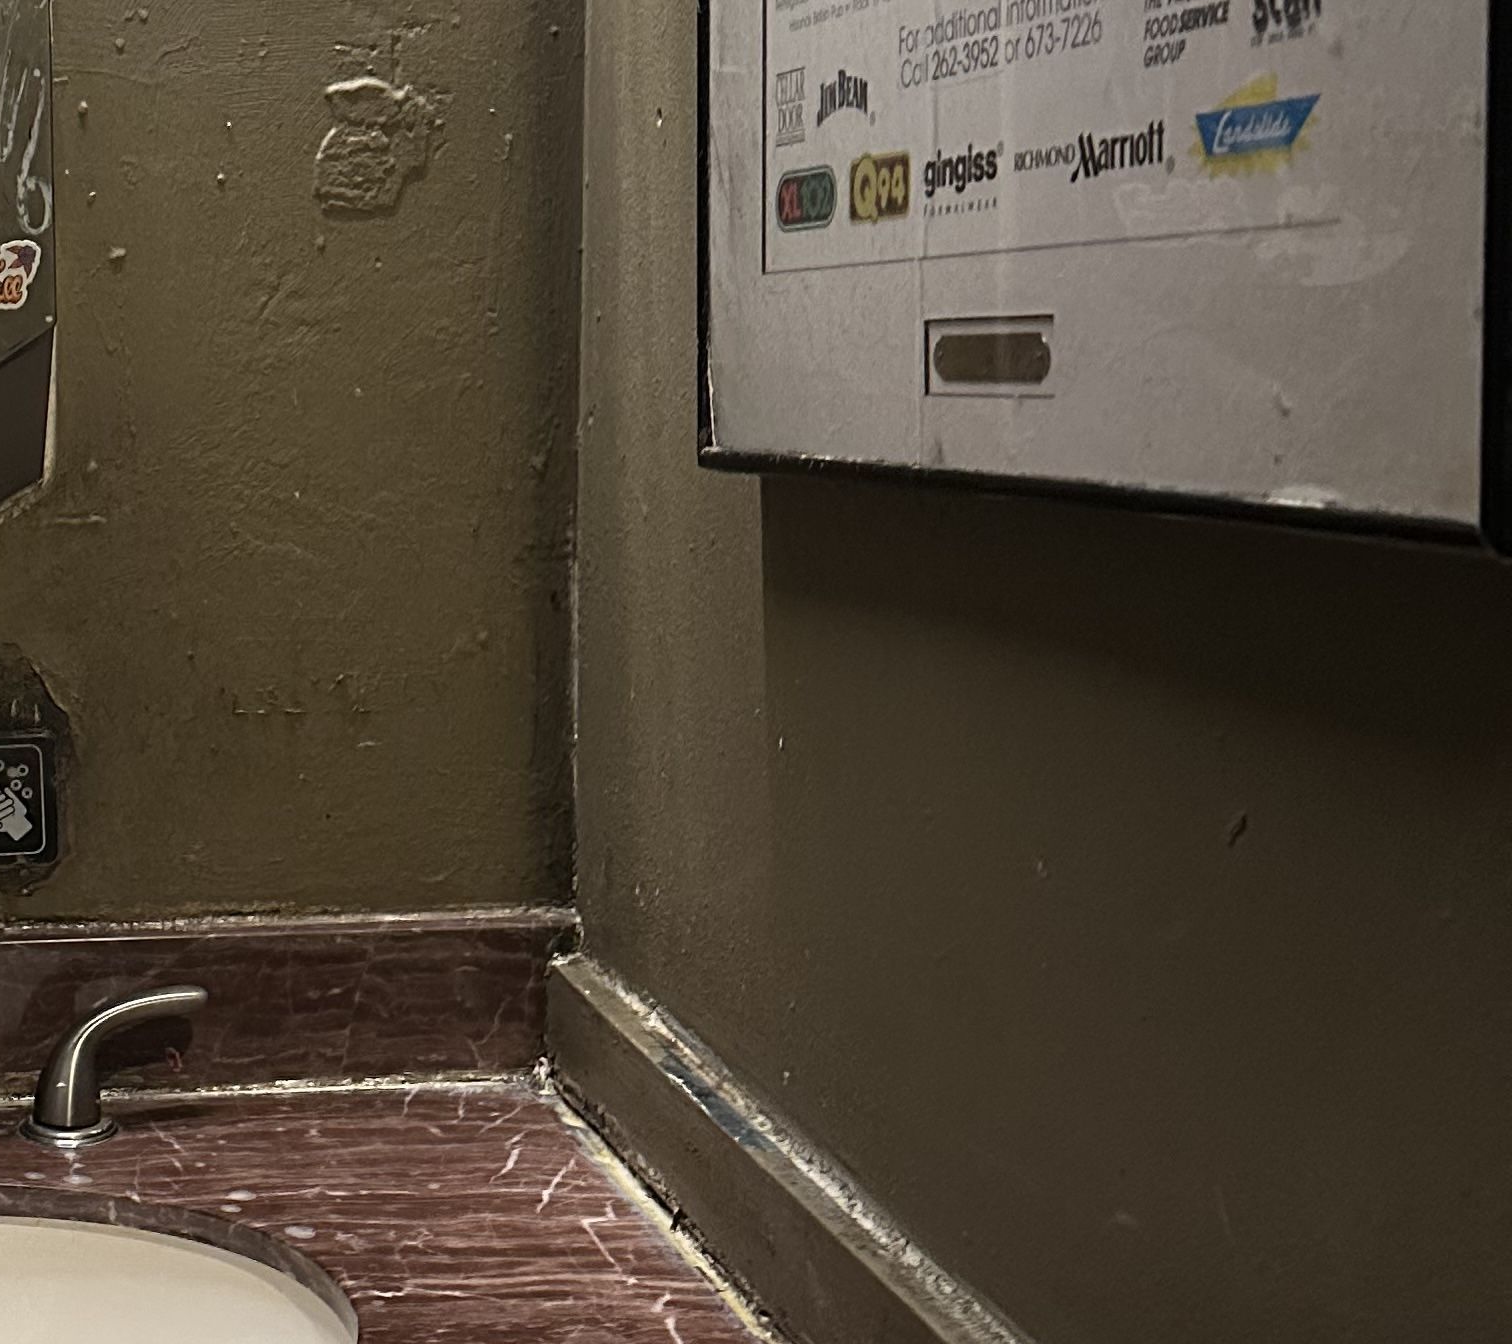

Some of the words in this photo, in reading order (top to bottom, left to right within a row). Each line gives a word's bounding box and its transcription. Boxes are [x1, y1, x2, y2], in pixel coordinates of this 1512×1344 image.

[898, 24, 920, 57] For
[925, 0, 1002, 50] additional
[900, 53, 930, 89] Call
[931, 34, 1000, 83] 262-3952
[1004, 37, 1021, 64] or
[1024, 10, 1103, 60] 673-7226
[1143, 38, 1187, 69] GROUP
[776, 103, 805, 134] DOOR
[838, 67, 869, 115] BEAM
[923, 142, 999, 198] gingiss
[1012, 142, 1076, 173] RICHMOND
[1069, 118, 1166, 190] Marriott
[852, 151, 908, 224] Q94
